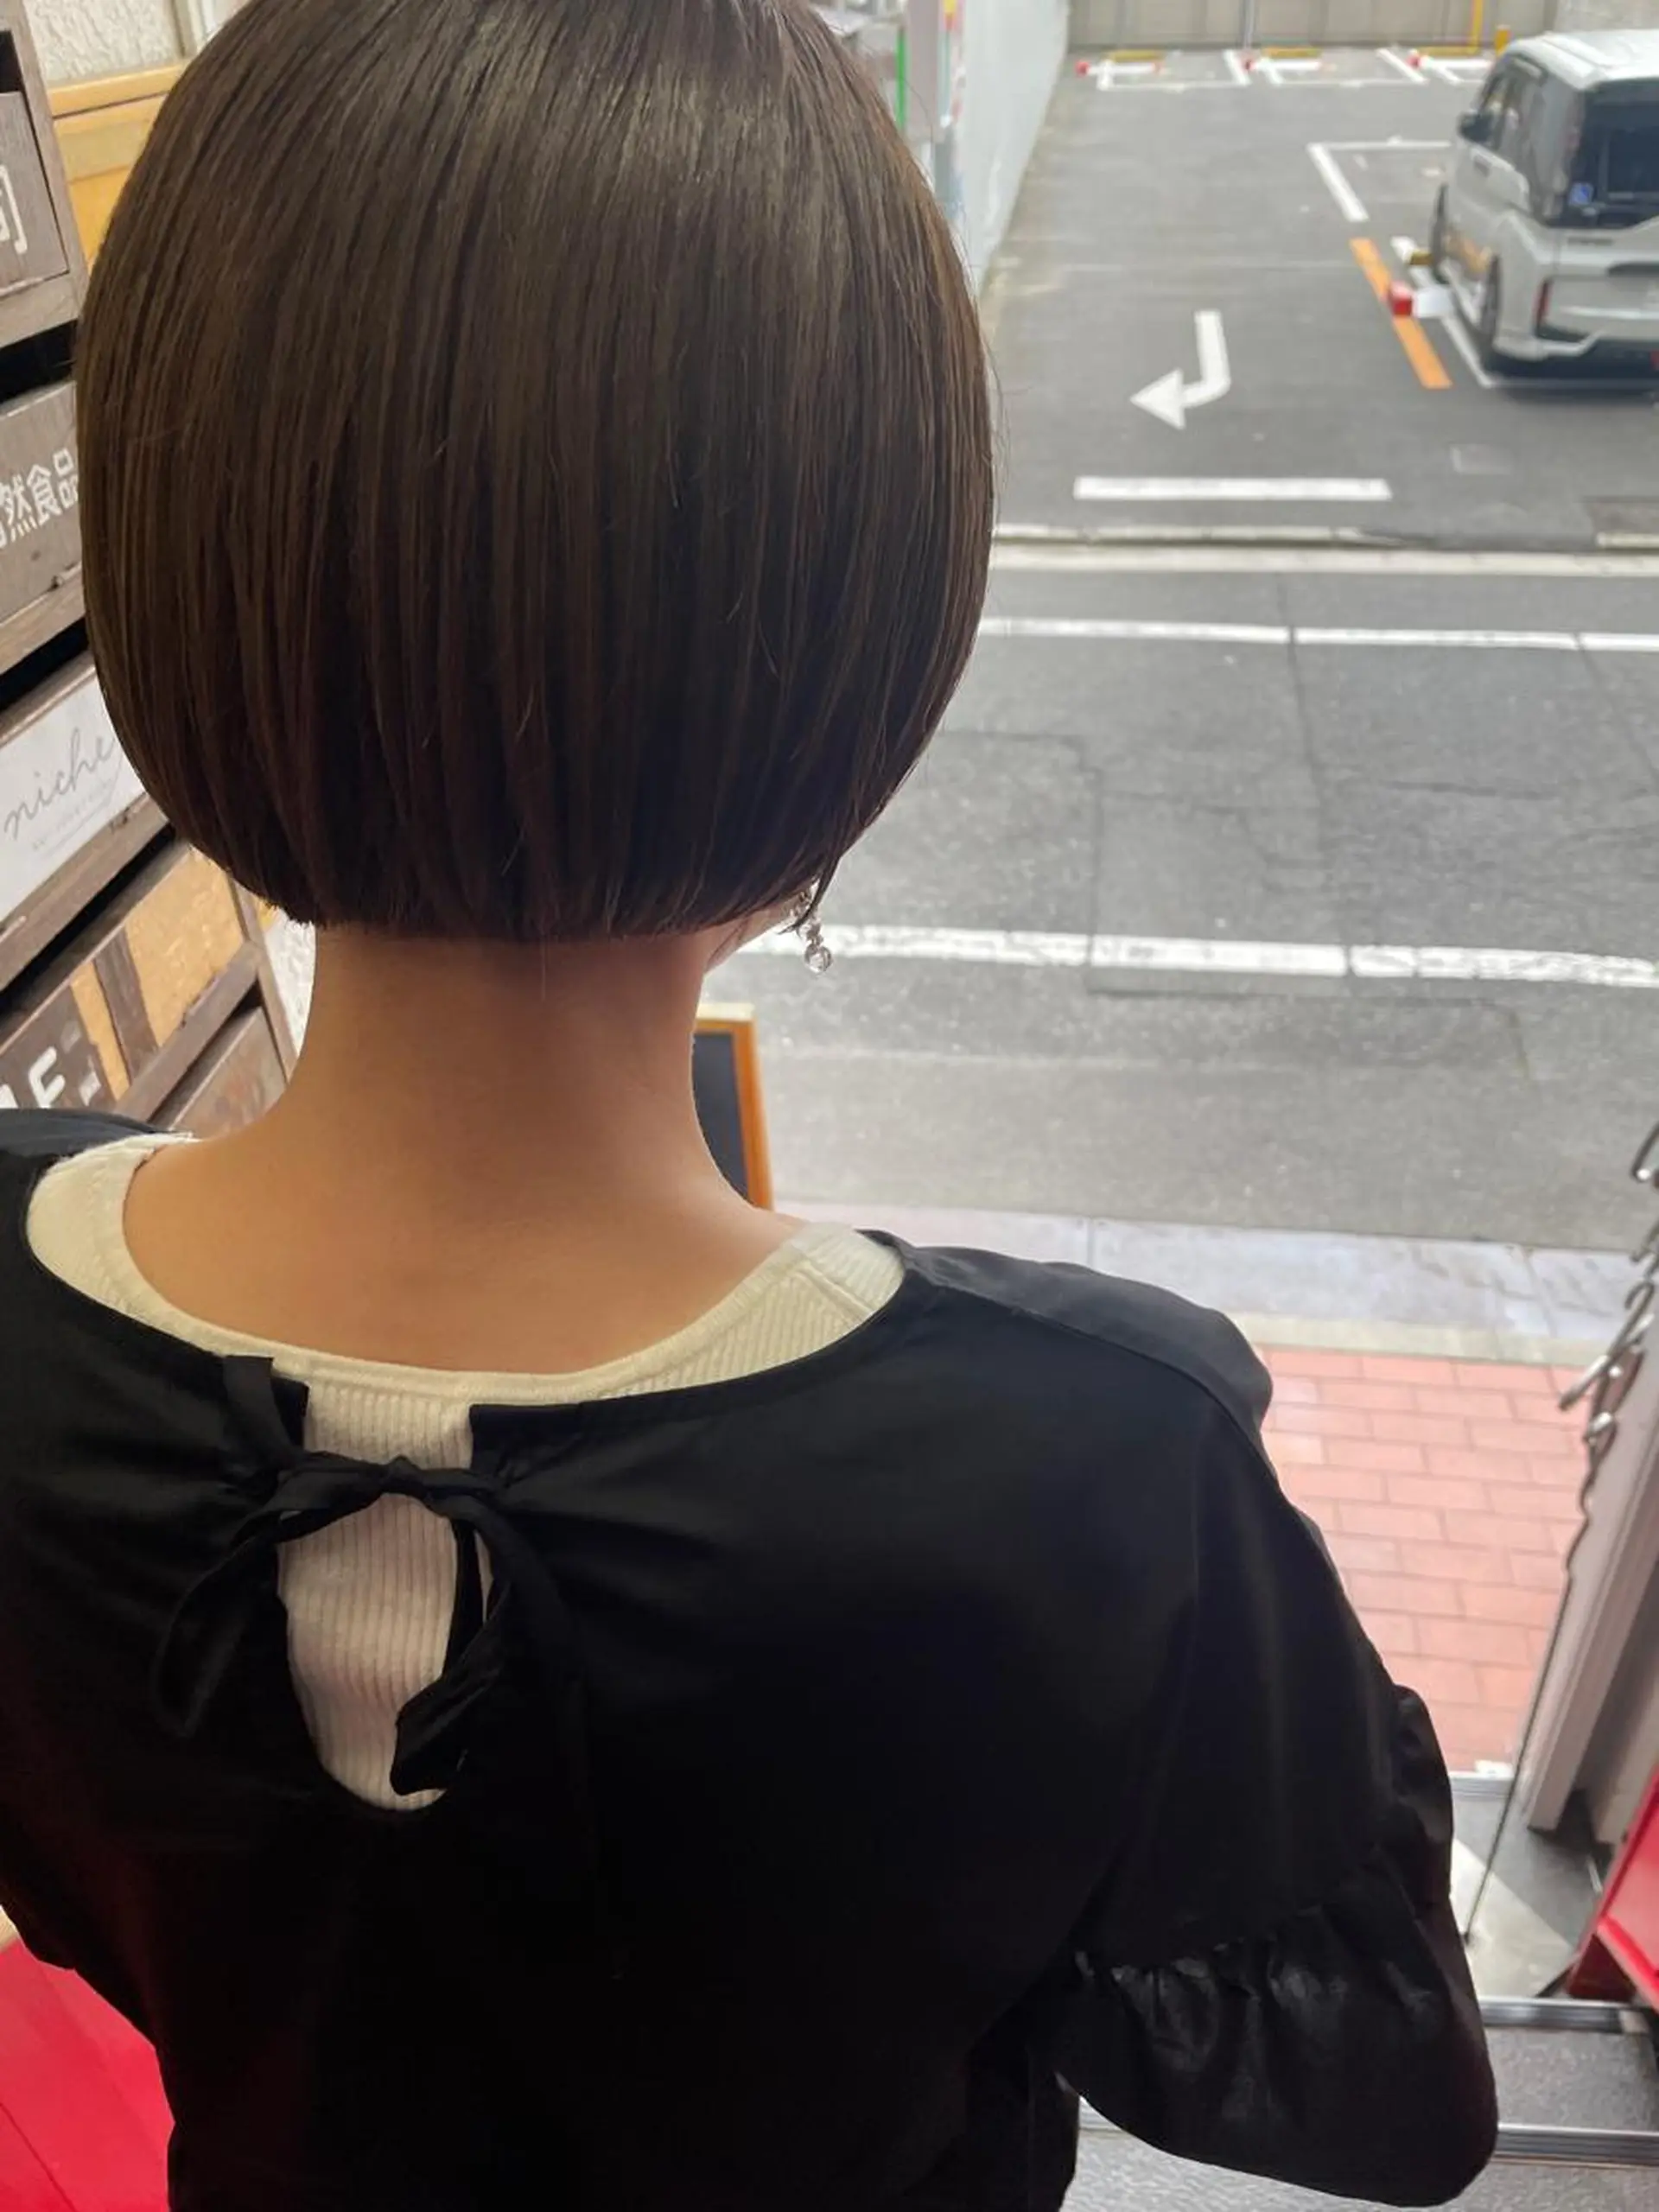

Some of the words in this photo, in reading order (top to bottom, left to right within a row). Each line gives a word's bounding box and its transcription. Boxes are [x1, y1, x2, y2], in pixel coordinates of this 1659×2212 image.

[0, 448, 79, 549] 然食品
[3, 728, 116, 841] niche
